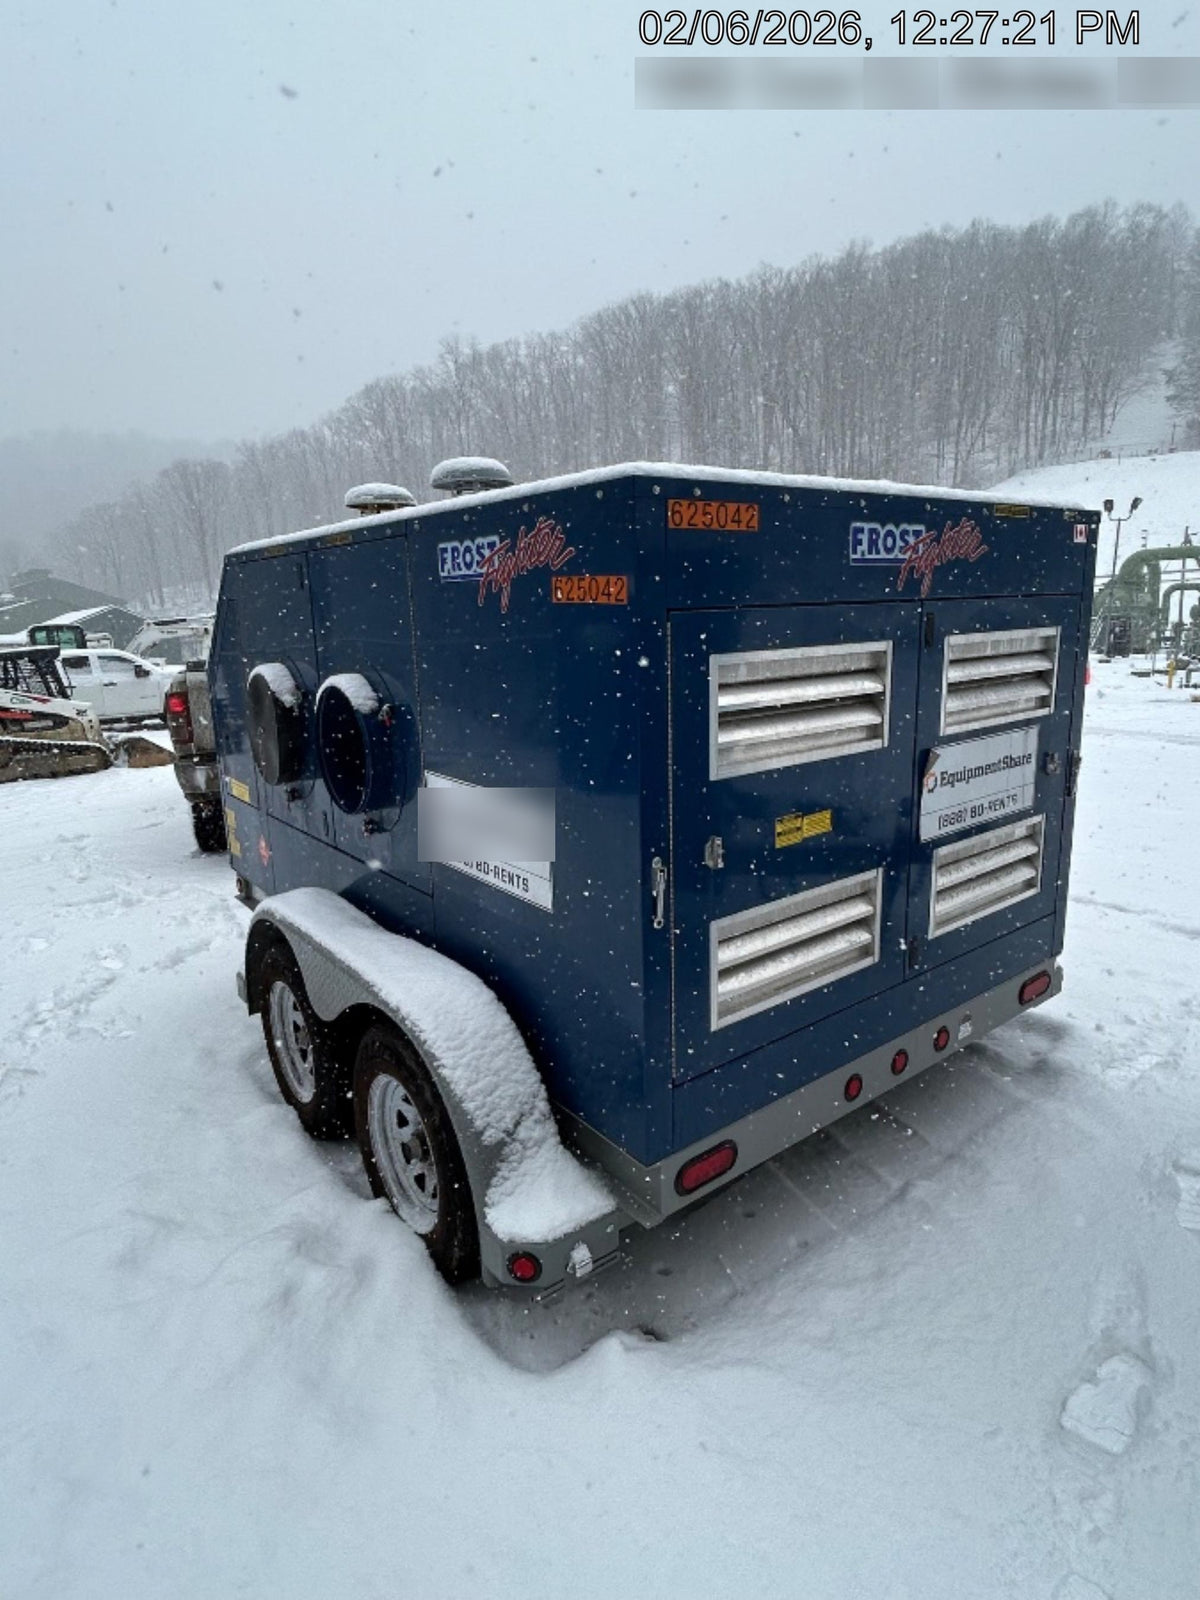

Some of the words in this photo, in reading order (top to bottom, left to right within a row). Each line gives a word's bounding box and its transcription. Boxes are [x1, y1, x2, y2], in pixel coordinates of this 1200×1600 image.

[670, 503, 757, 529] 625042
[438, 536, 499, 576] FROST
[850, 524, 925, 557] FROST
[553, 578, 626, 602] 625042
[939, 752, 1032, 788] EquipmentShare
